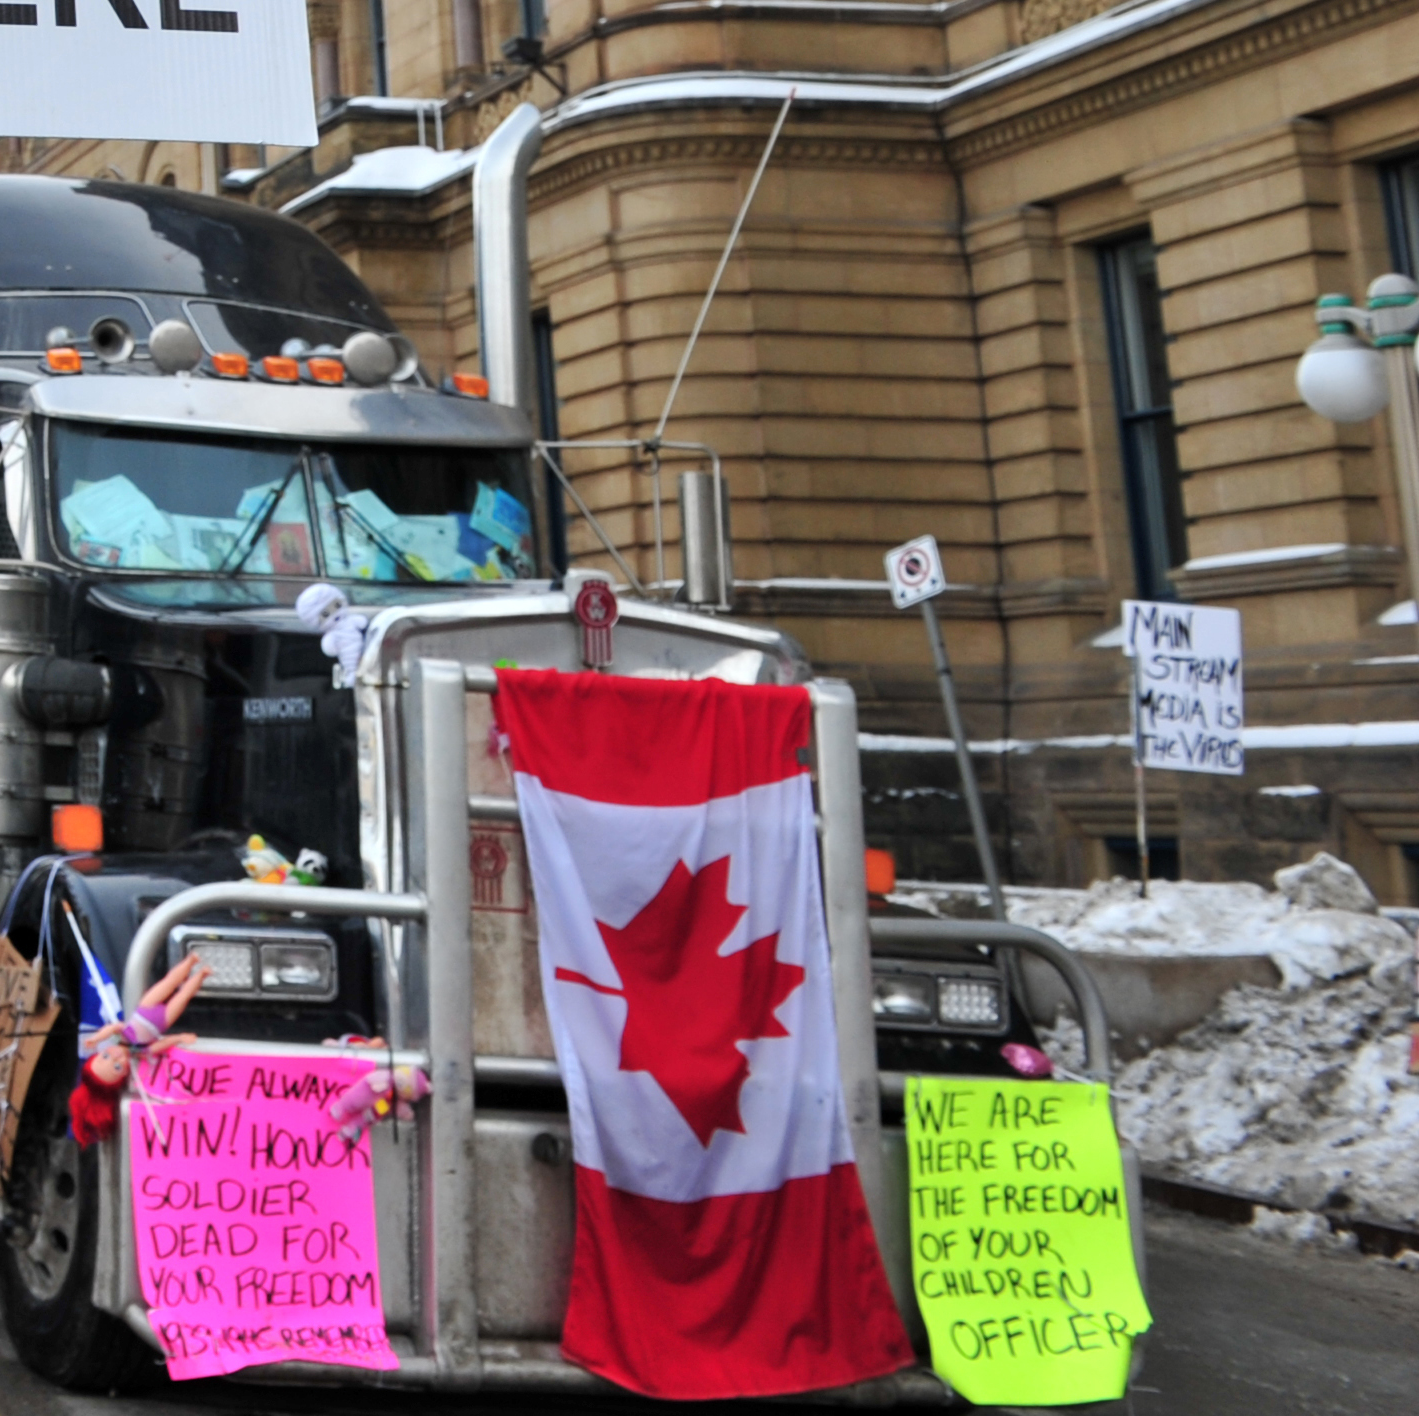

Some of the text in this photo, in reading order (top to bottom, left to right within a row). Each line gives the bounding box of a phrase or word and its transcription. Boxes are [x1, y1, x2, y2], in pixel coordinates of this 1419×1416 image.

[1130, 606, 1194, 650] MAIN
[1144, 655, 1241, 694] STREAM
[1139, 689, 1208, 730] MEDIA
[1141, 733, 1180, 762] THE
[148, 1055, 232, 1097] TRUE
[914, 1090, 1065, 1133] WE ARE
[916, 1139, 1077, 1176] HERE FOR
[913, 1185, 1123, 1220] THE FREEDOM
[149, 1221, 361, 1264] DEAD FOR
[918, 1228, 1065, 1266] OF YOUR
[148, 1264, 377, 1309] YOUR FREEDOM
[919, 1269, 1093, 1301] CHILDREN
